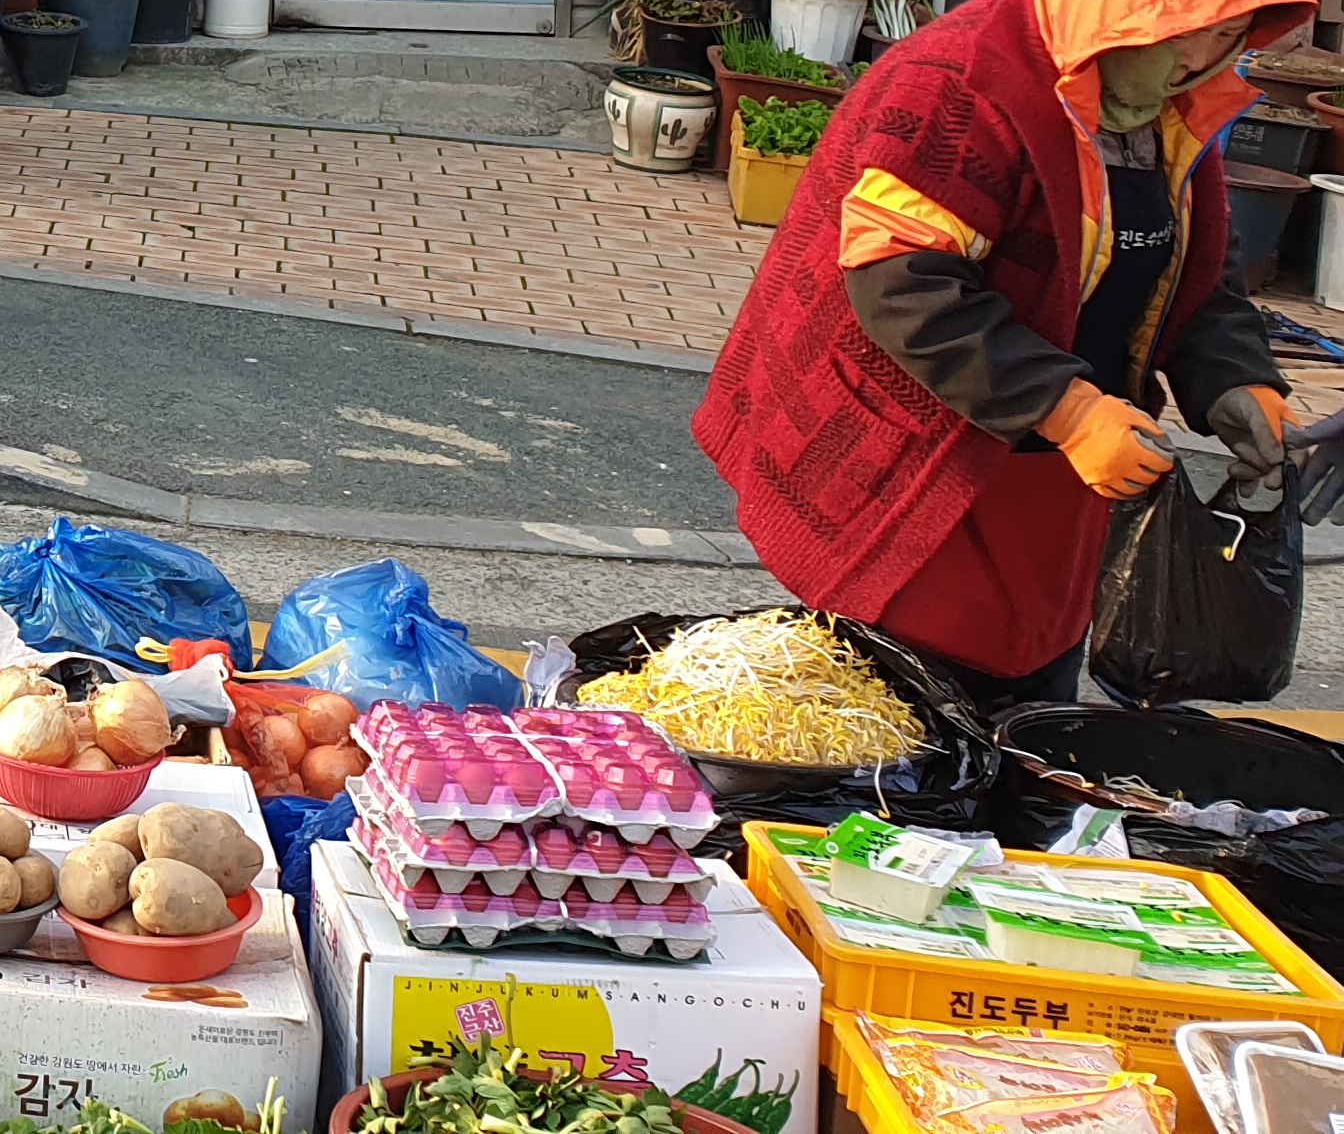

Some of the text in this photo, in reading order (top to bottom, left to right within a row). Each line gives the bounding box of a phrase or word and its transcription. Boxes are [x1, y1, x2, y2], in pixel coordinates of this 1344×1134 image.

[949, 991, 1070, 1030] 진도두부
[18, 1053, 49, 1067] 건강한
[52, 1056, 84, 1070] 강원도
[86, 1059, 118, 1075] 땅에서
[149, 1060, 188, 1084] Fresh
[14, 1073, 99, 1117] 감자
